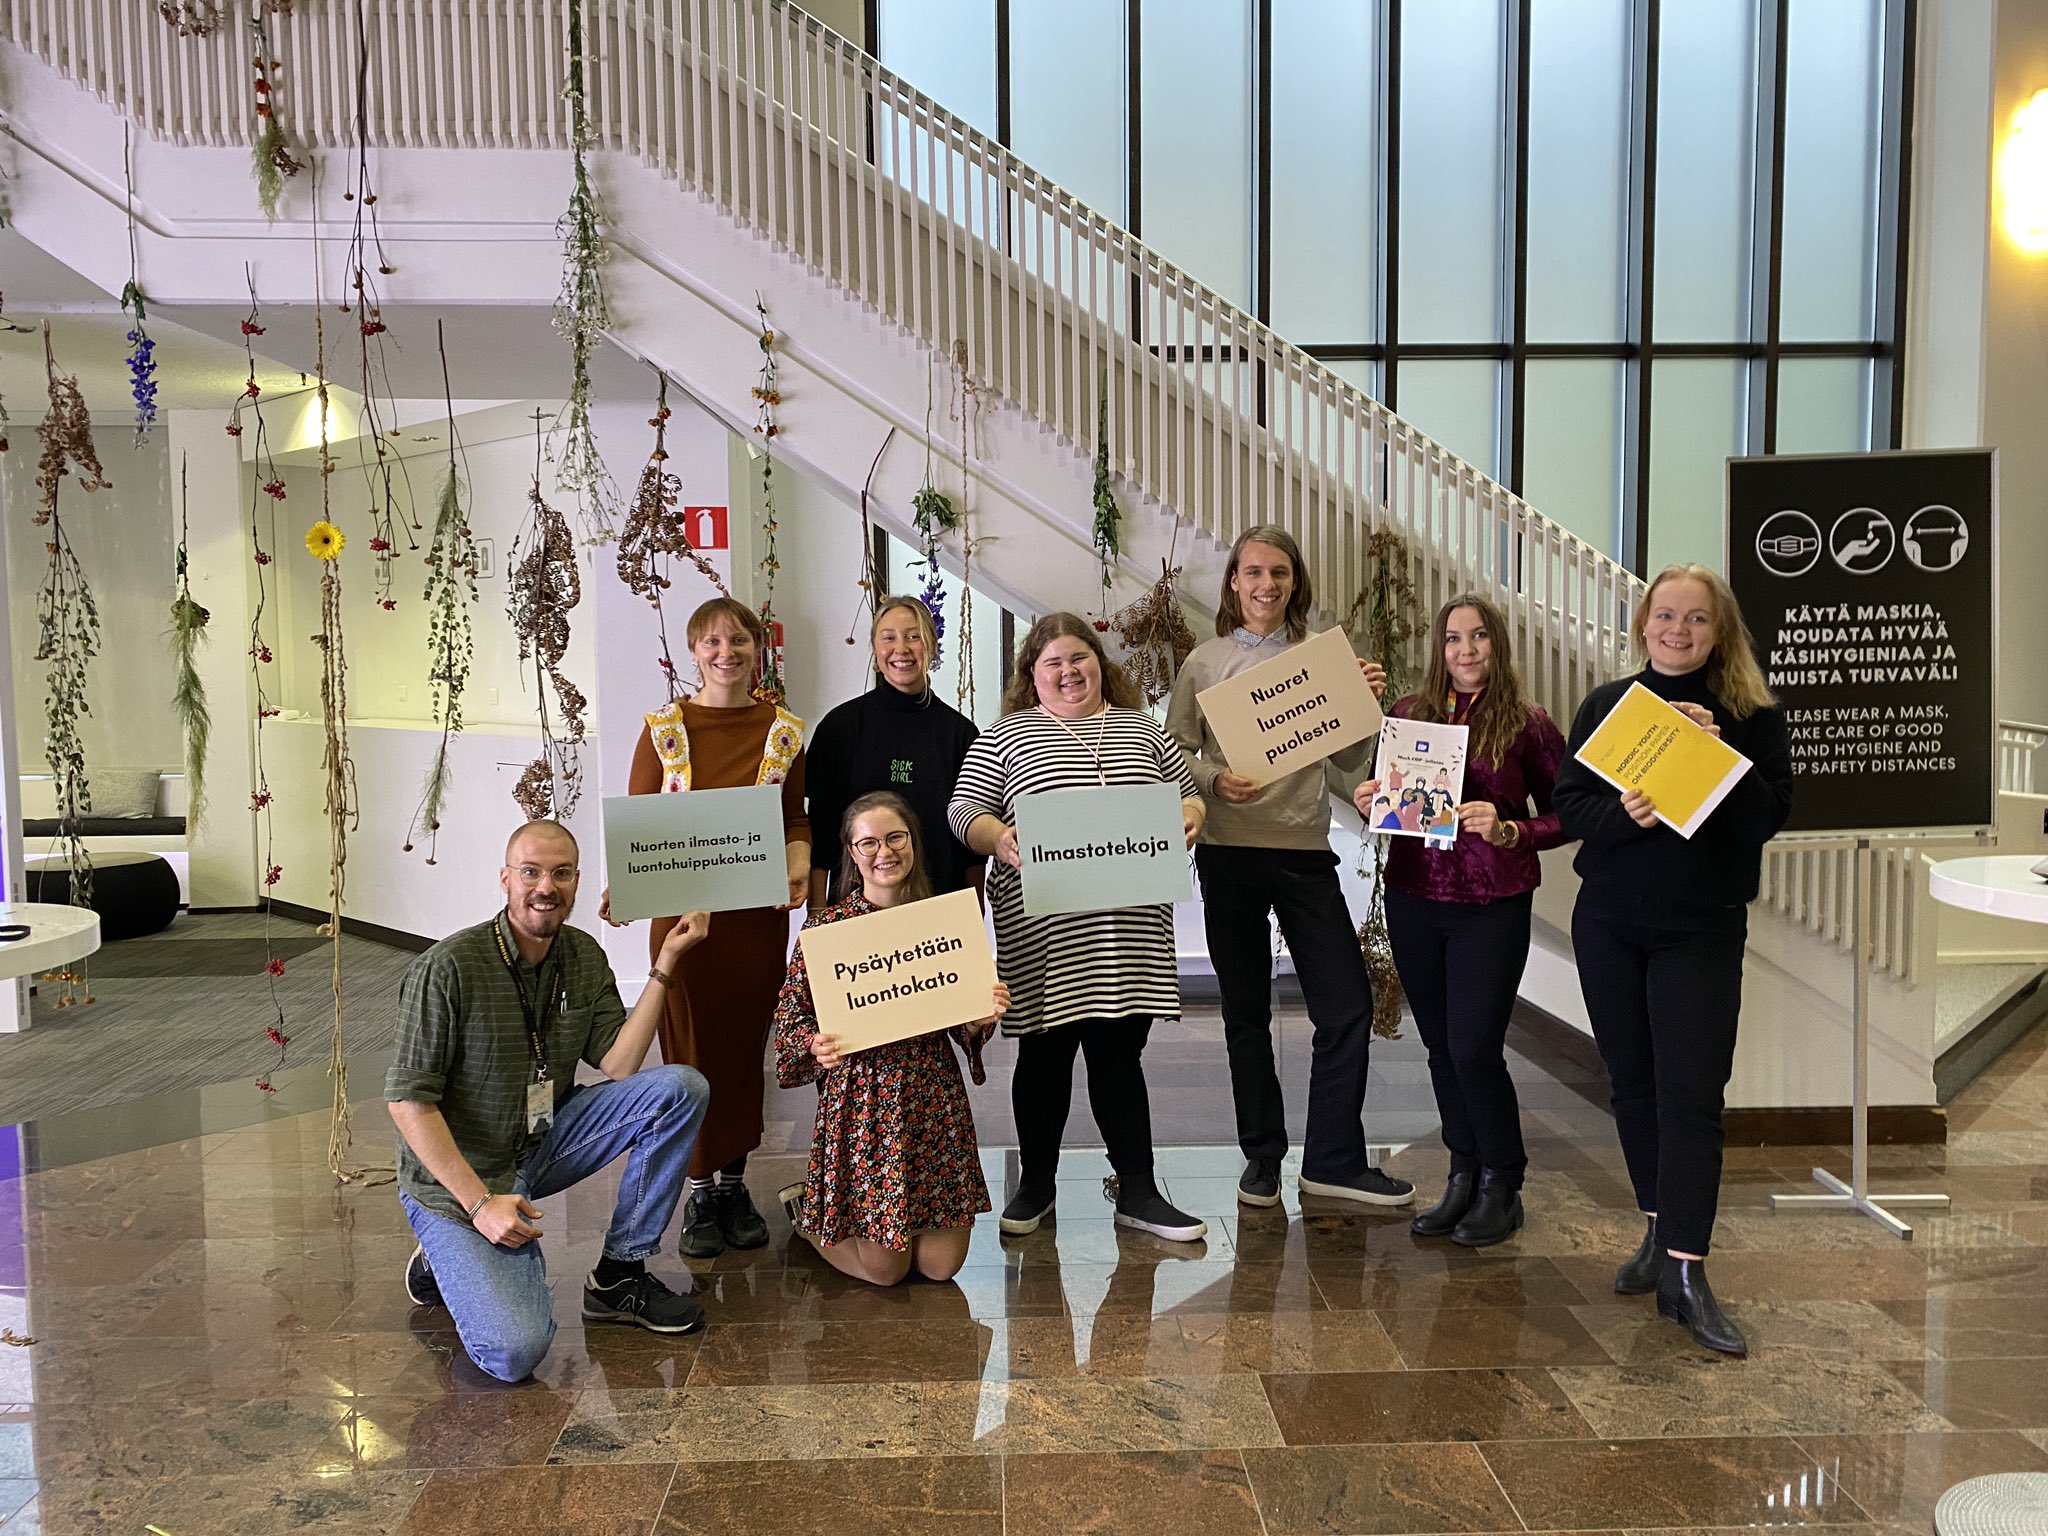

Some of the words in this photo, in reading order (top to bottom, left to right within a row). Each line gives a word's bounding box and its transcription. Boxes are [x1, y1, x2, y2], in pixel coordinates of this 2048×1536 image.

[1785, 603, 1850, 623] KÄYTÄ
[1857, 603, 1941, 621] MASKIA,
[1778, 626, 1874, 644] NOUDATA
[1880, 621, 1949, 641] HYVÄÄ
[1770, 646, 1926, 665] KÄSIHYGIENIAA
[1932, 645, 1956, 660] JA
[1768, 669, 1843, 686] MUISTA
[1849, 662, 1958, 684] TURVAVÄLI
[1250, 668, 1311, 705] Nuoret
[1256, 693, 1328, 733] luonnon
[1784, 708, 1831, 723] LEASE
[1835, 707, 1880, 721] WEAR
[1884, 706, 1895, 719] A
[1900, 705, 1949, 720] MASK,
[1265, 718, 1341, 765] puolesta
[1787, 726, 1821, 740] AKE
[1825, 725, 1865, 739] CARE
[1869, 724, 1890, 737] OF
[1895, 722, 1943, 737] GOOD
[1616, 747, 1640, 774] NORDIC
[1638, 724, 1658, 746] YOUTH
[1623, 747, 1652, 779] POSITION
[1649, 725, 1670, 748] PAPER
[1631, 773, 1643, 785] ON
[1641, 727, 1680, 773] BIODIVERSITY
[1835, 742, 1903, 756] HYGIENE
[1907, 740, 1942, 753] AND
[891, 758, 913, 771] SICK
[1811, 760, 1866, 774] SAFETY
[1871, 757, 1956, 772] DISTANCES
[891, 771, 912, 783] GIRL
[630, 840, 685, 853] Nuorten
[689, 835, 744, 848] ilmasto-
[748, 832, 761, 845] ja
[1032, 835, 1169, 863] Ilmastotekoja
[628, 851, 767, 874] luontohuippukokous
[834, 936, 963, 983] Pysäytetään
[846, 970, 959, 1010] luontokato
